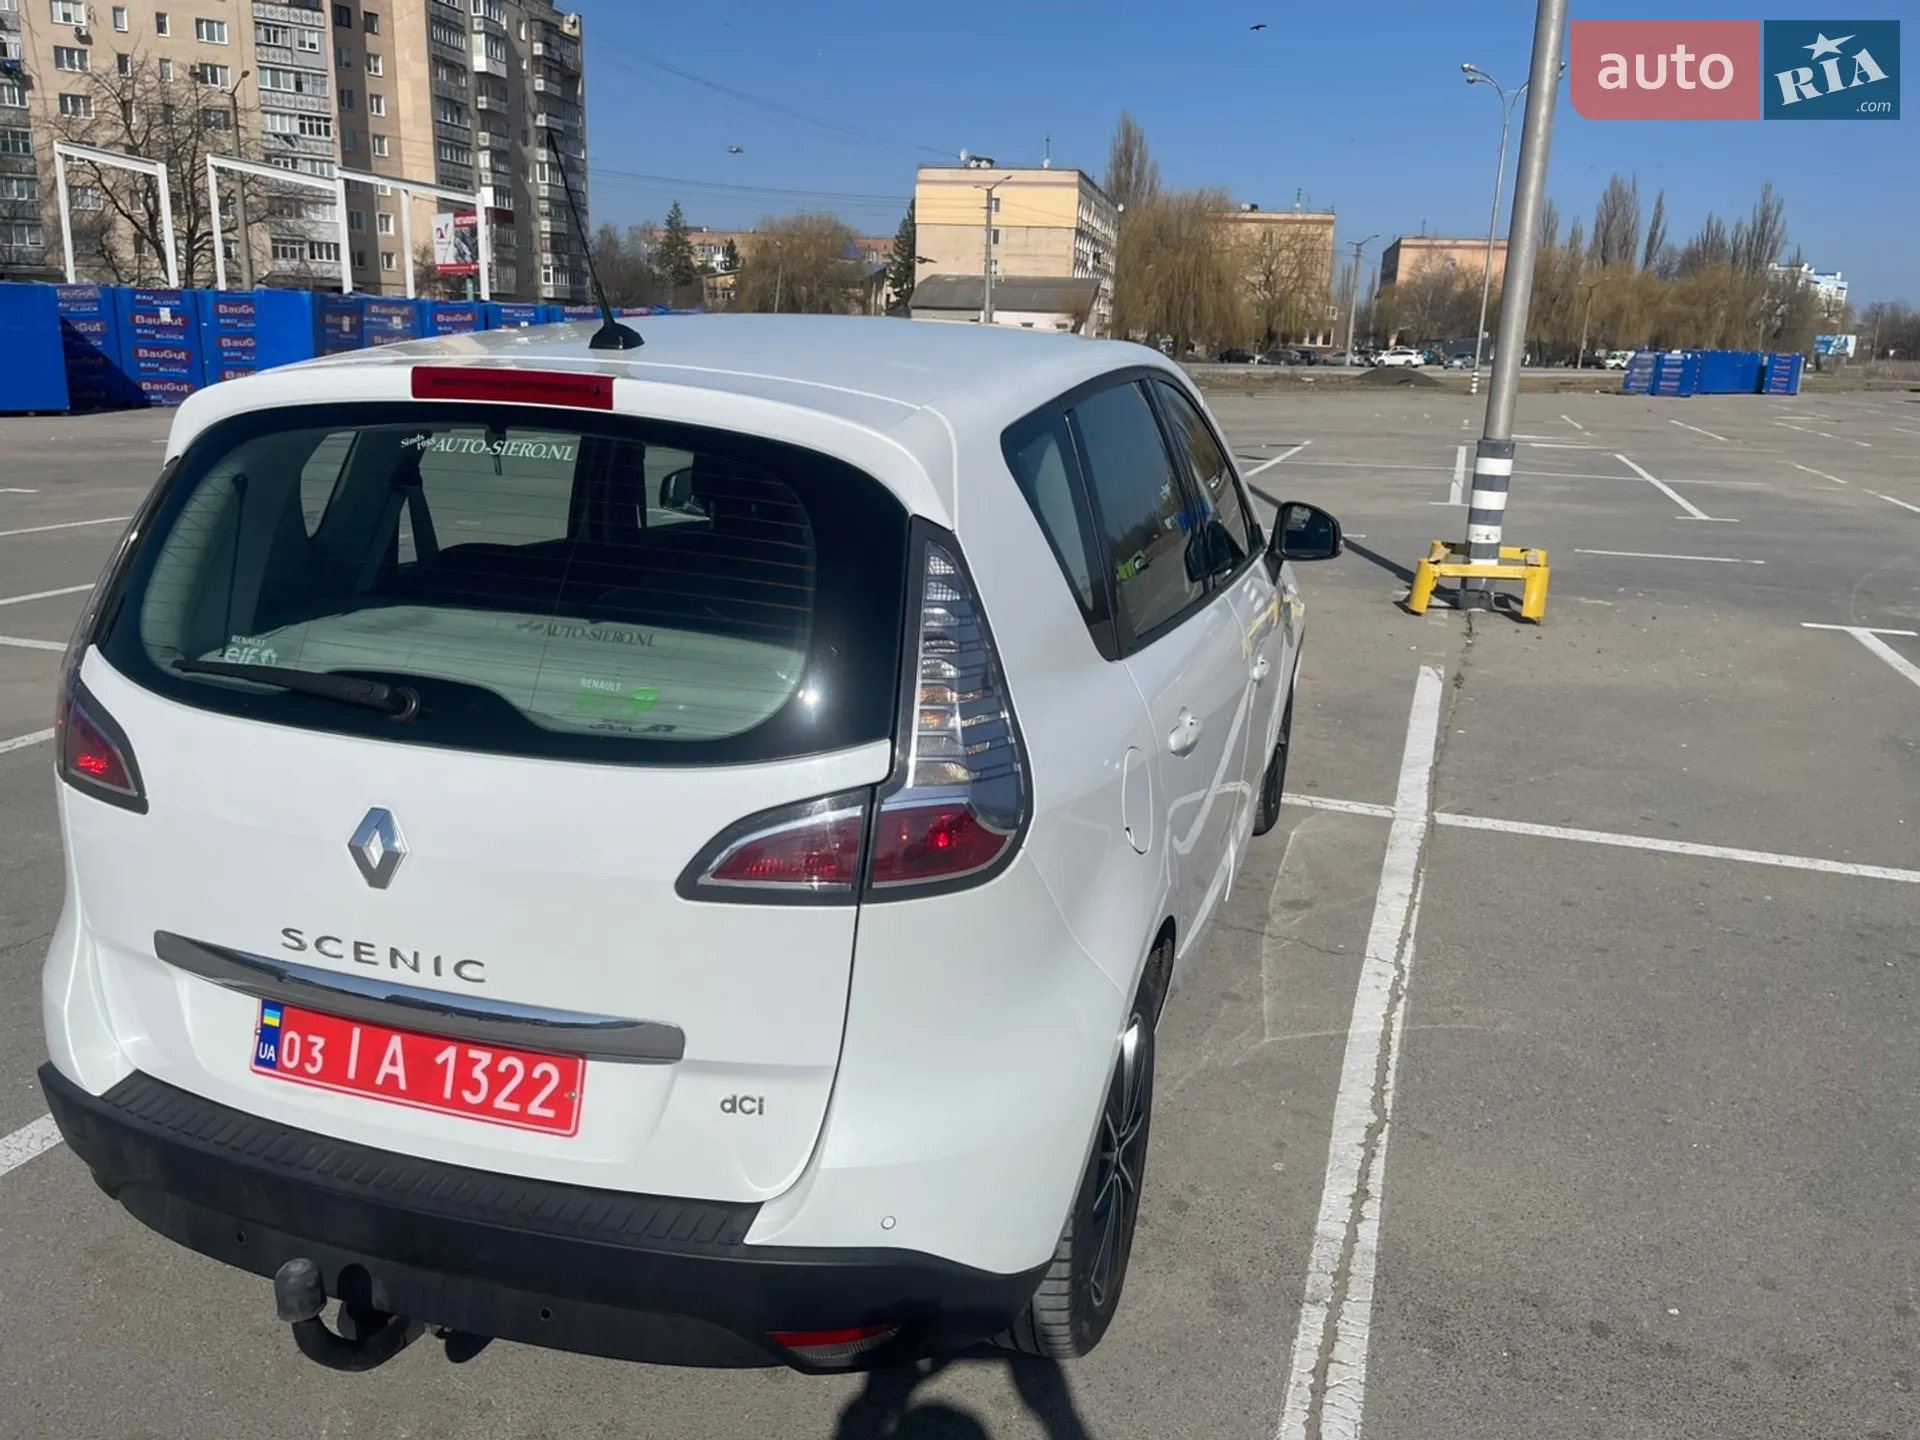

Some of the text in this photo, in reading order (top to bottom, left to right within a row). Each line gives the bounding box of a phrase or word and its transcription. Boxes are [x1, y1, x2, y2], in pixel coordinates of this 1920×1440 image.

[138, 348, 188, 360] BauGut
[141, 381, 192, 393] BauGut
[431, 437, 574, 461] AUTO-SIERO.NL
[579, 677, 622, 693] RENAULT
[281, 927, 487, 983] SCENIC
[258, 1040, 277, 1062] UA
[281, 1031, 326, 1074] 03
[434, 1045, 561, 1119] 1322
